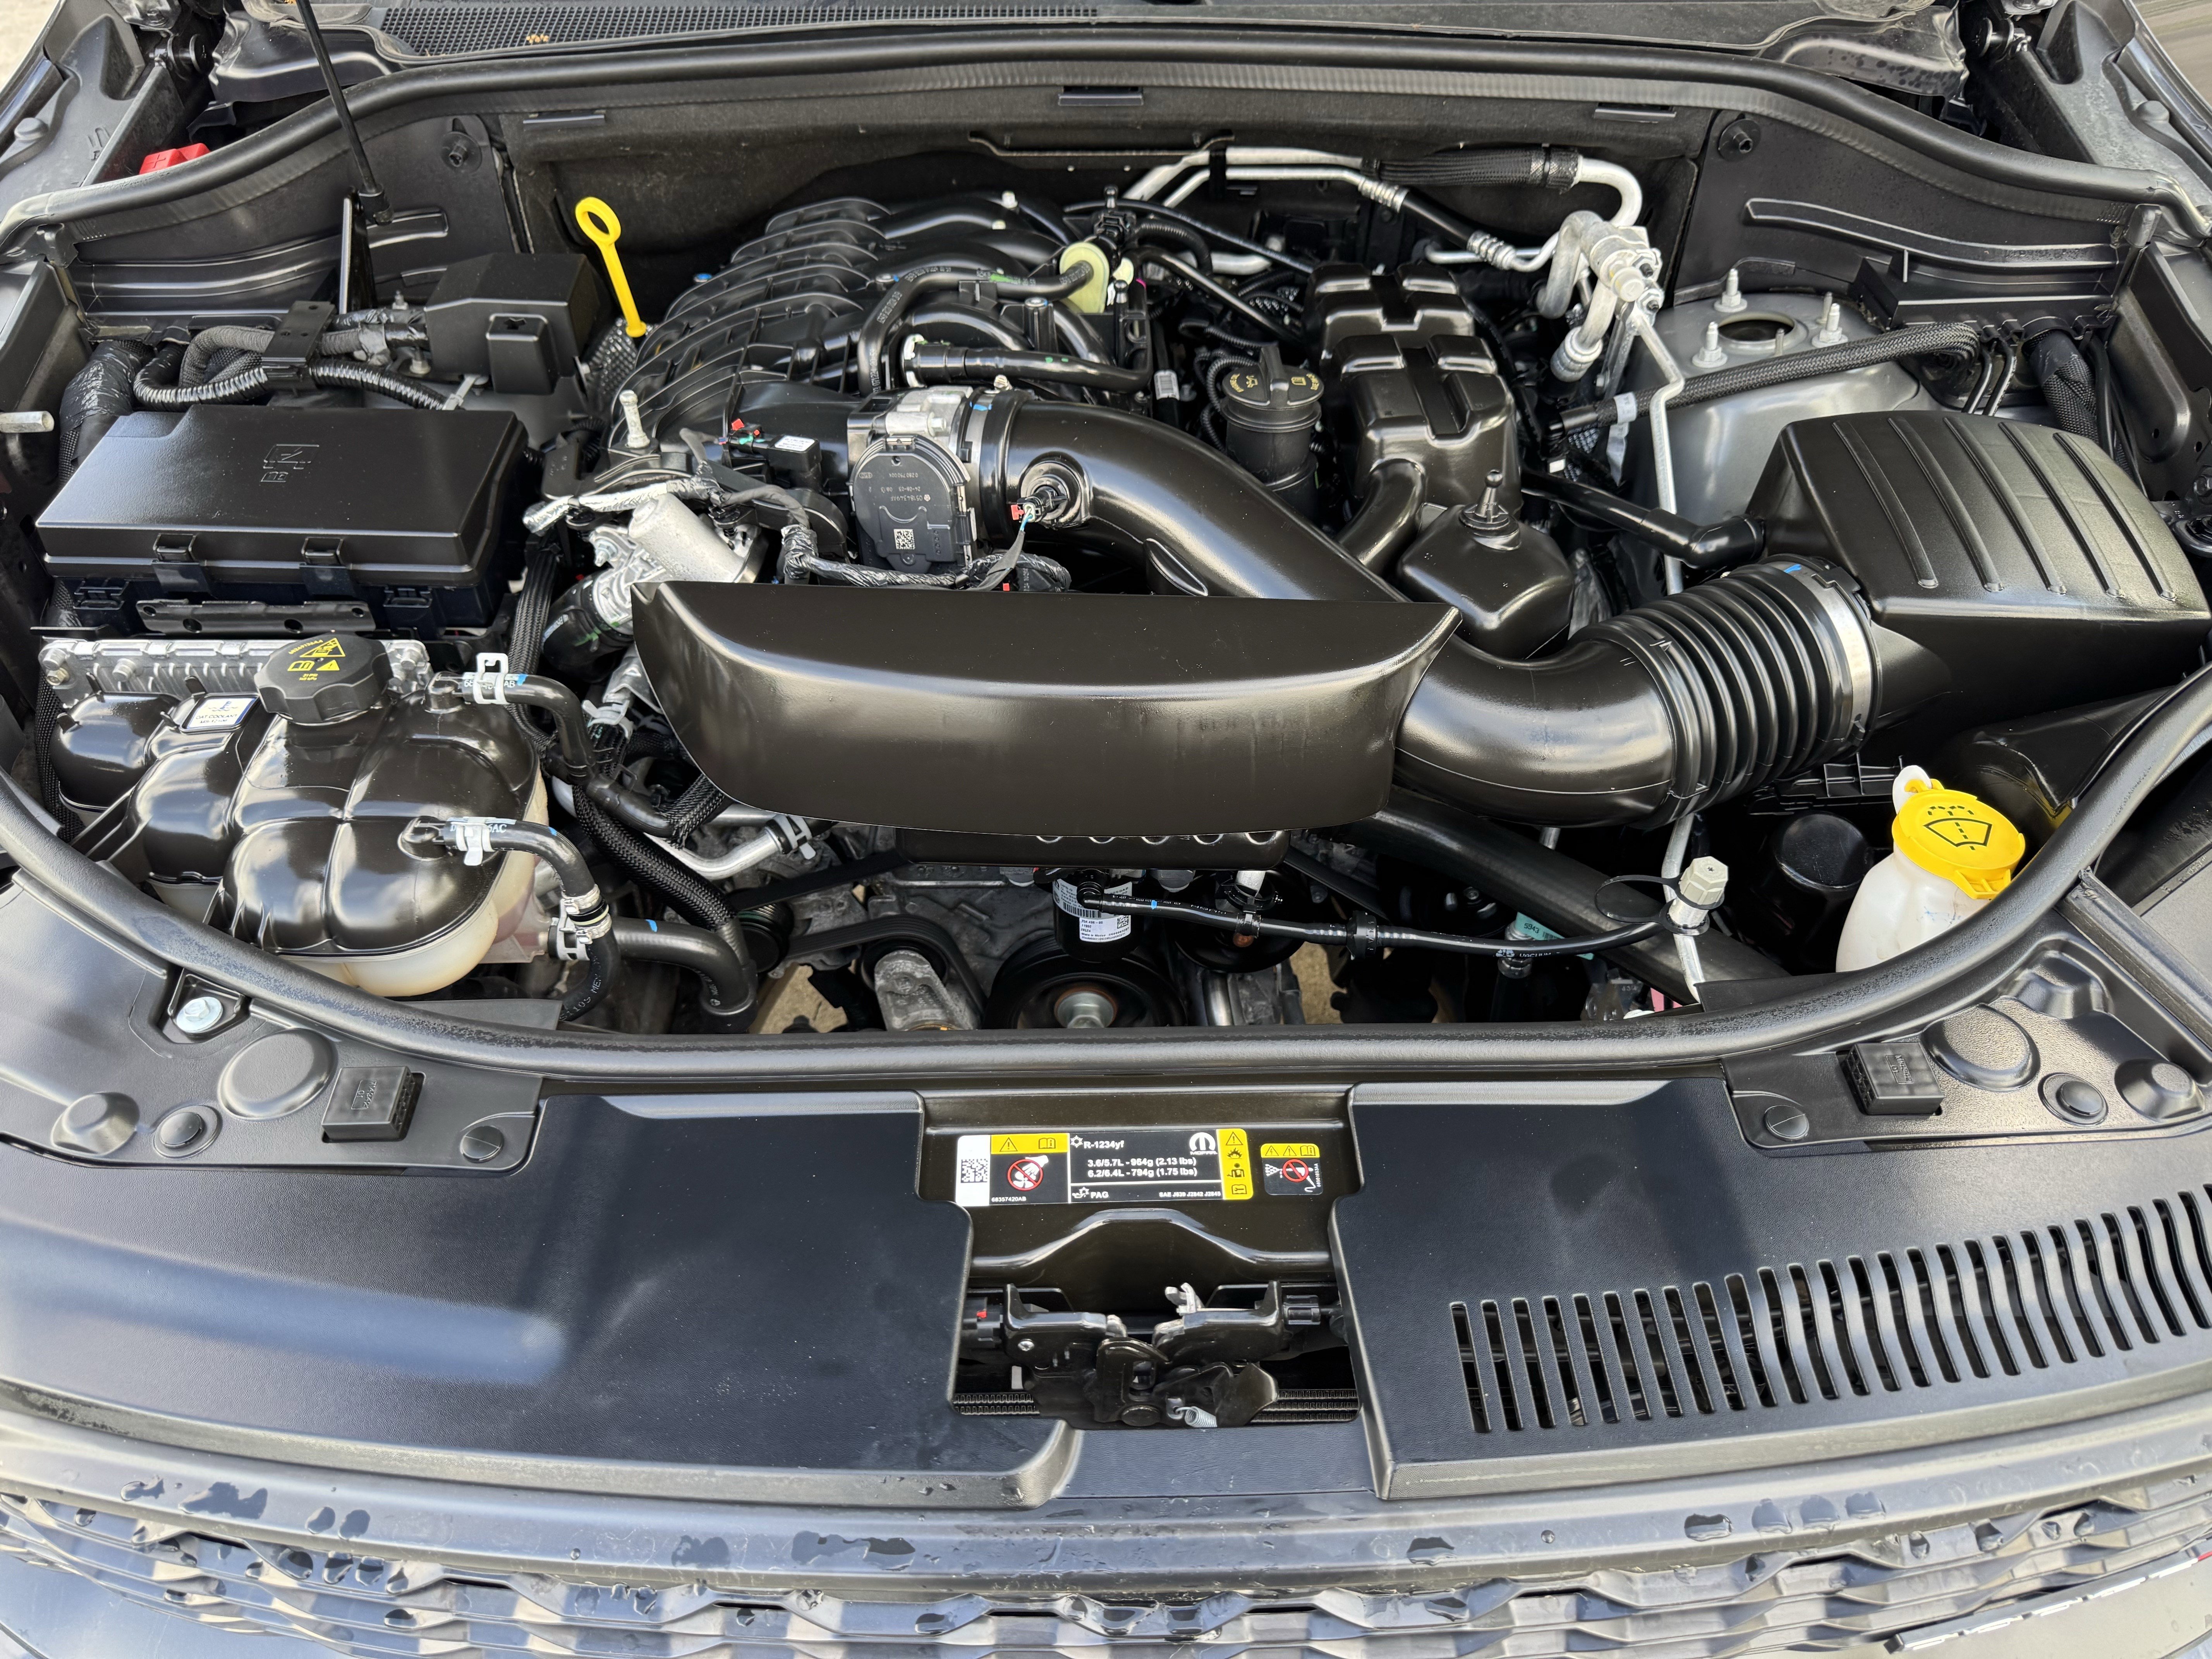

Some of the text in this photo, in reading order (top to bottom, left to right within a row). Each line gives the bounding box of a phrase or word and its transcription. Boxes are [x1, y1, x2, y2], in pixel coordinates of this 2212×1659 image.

[1084, 1140, 1125, 1150] R-1234yf
[1087, 1159, 1124, 1168] 3.6/5.7L
[1155, 1157, 1178, 1167] (2.13
[1179, 1157, 1197, 1166] lbs)
[1087, 1169, 1125, 1178] 6.2/6.4L
[1156, 1168, 1179, 1177] (1.75
[1180, 1167, 1198, 1176] lbs)
[1090, 1191, 1110, 1199] PAG
